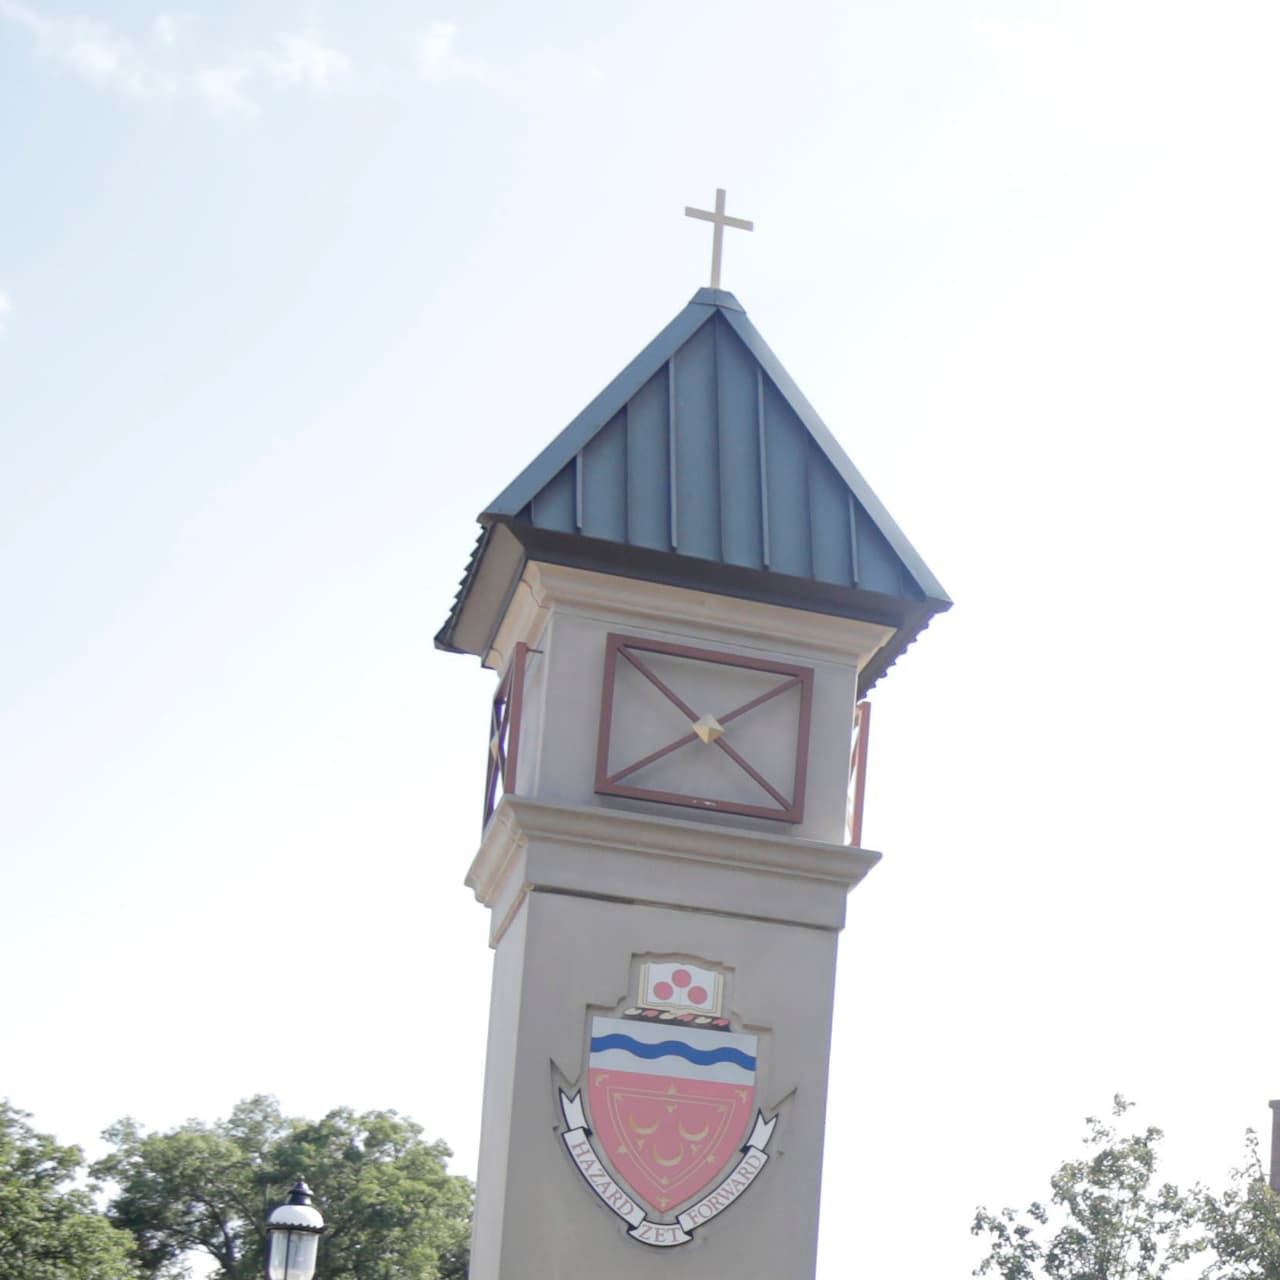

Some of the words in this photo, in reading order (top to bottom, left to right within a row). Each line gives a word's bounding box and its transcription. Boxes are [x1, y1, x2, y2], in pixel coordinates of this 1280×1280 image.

[571, 1141, 635, 1217] HAZARD
[638, 1223, 681, 1243] ZET
[687, 1153, 762, 1226] FORWARD
